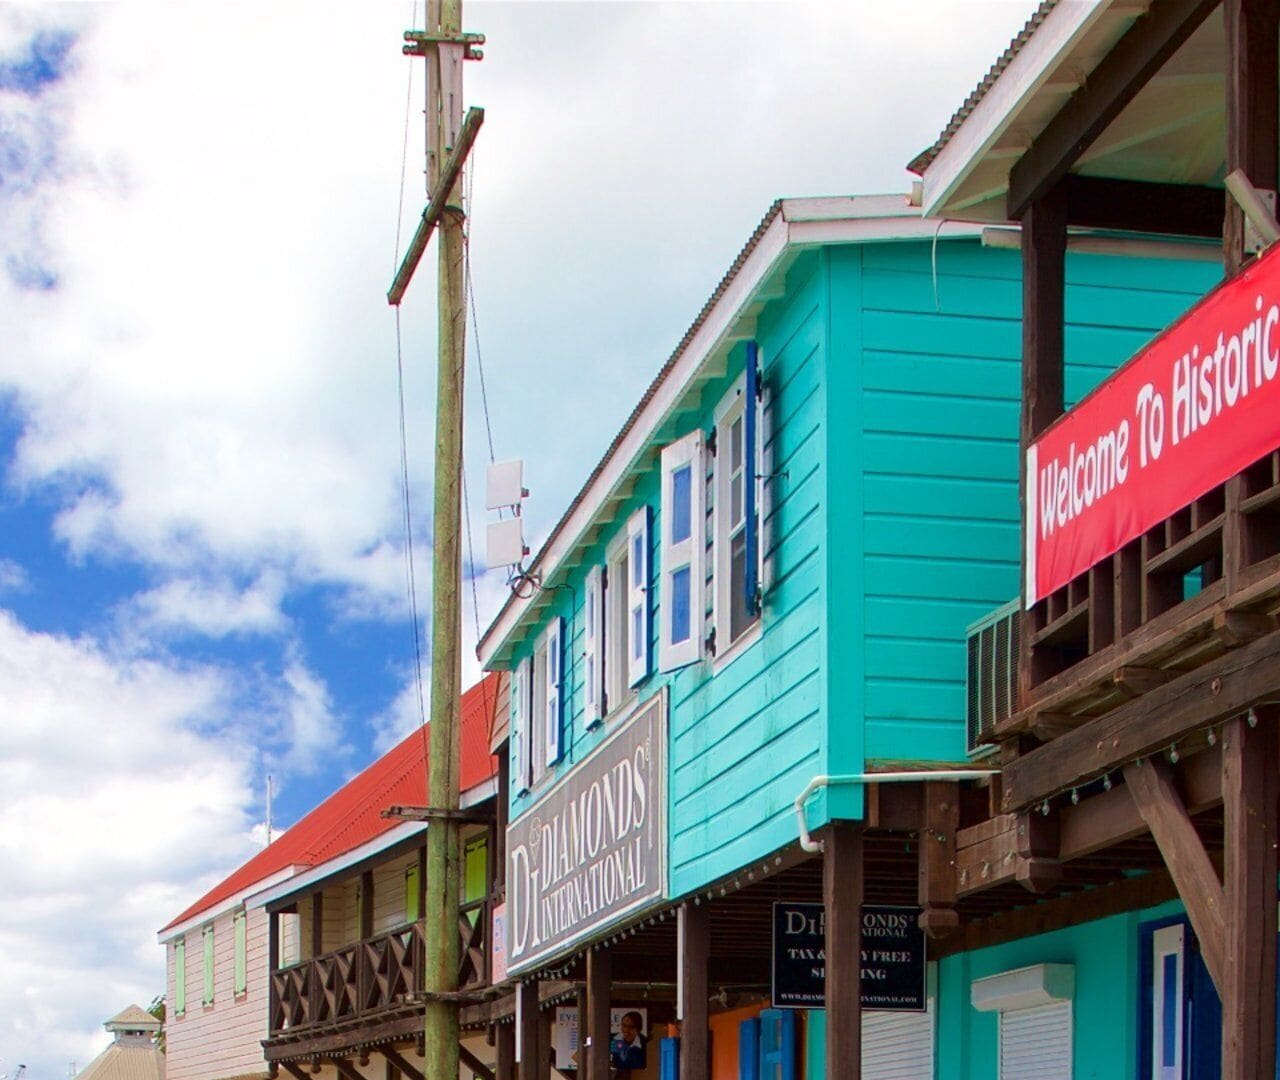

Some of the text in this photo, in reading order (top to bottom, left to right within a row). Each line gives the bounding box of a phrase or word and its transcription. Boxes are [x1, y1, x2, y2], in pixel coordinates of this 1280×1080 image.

[1040, 419, 1129, 541] Welcome
[1136, 383, 1164, 469] To
[1172, 295, 1280, 446] Historic
[541, 744, 647, 892] DIAMONDS
[541, 835, 647, 943] INTERNATIONAL
[787, 948, 815, 960] TAX
[872, 951, 911, 962] FREE
